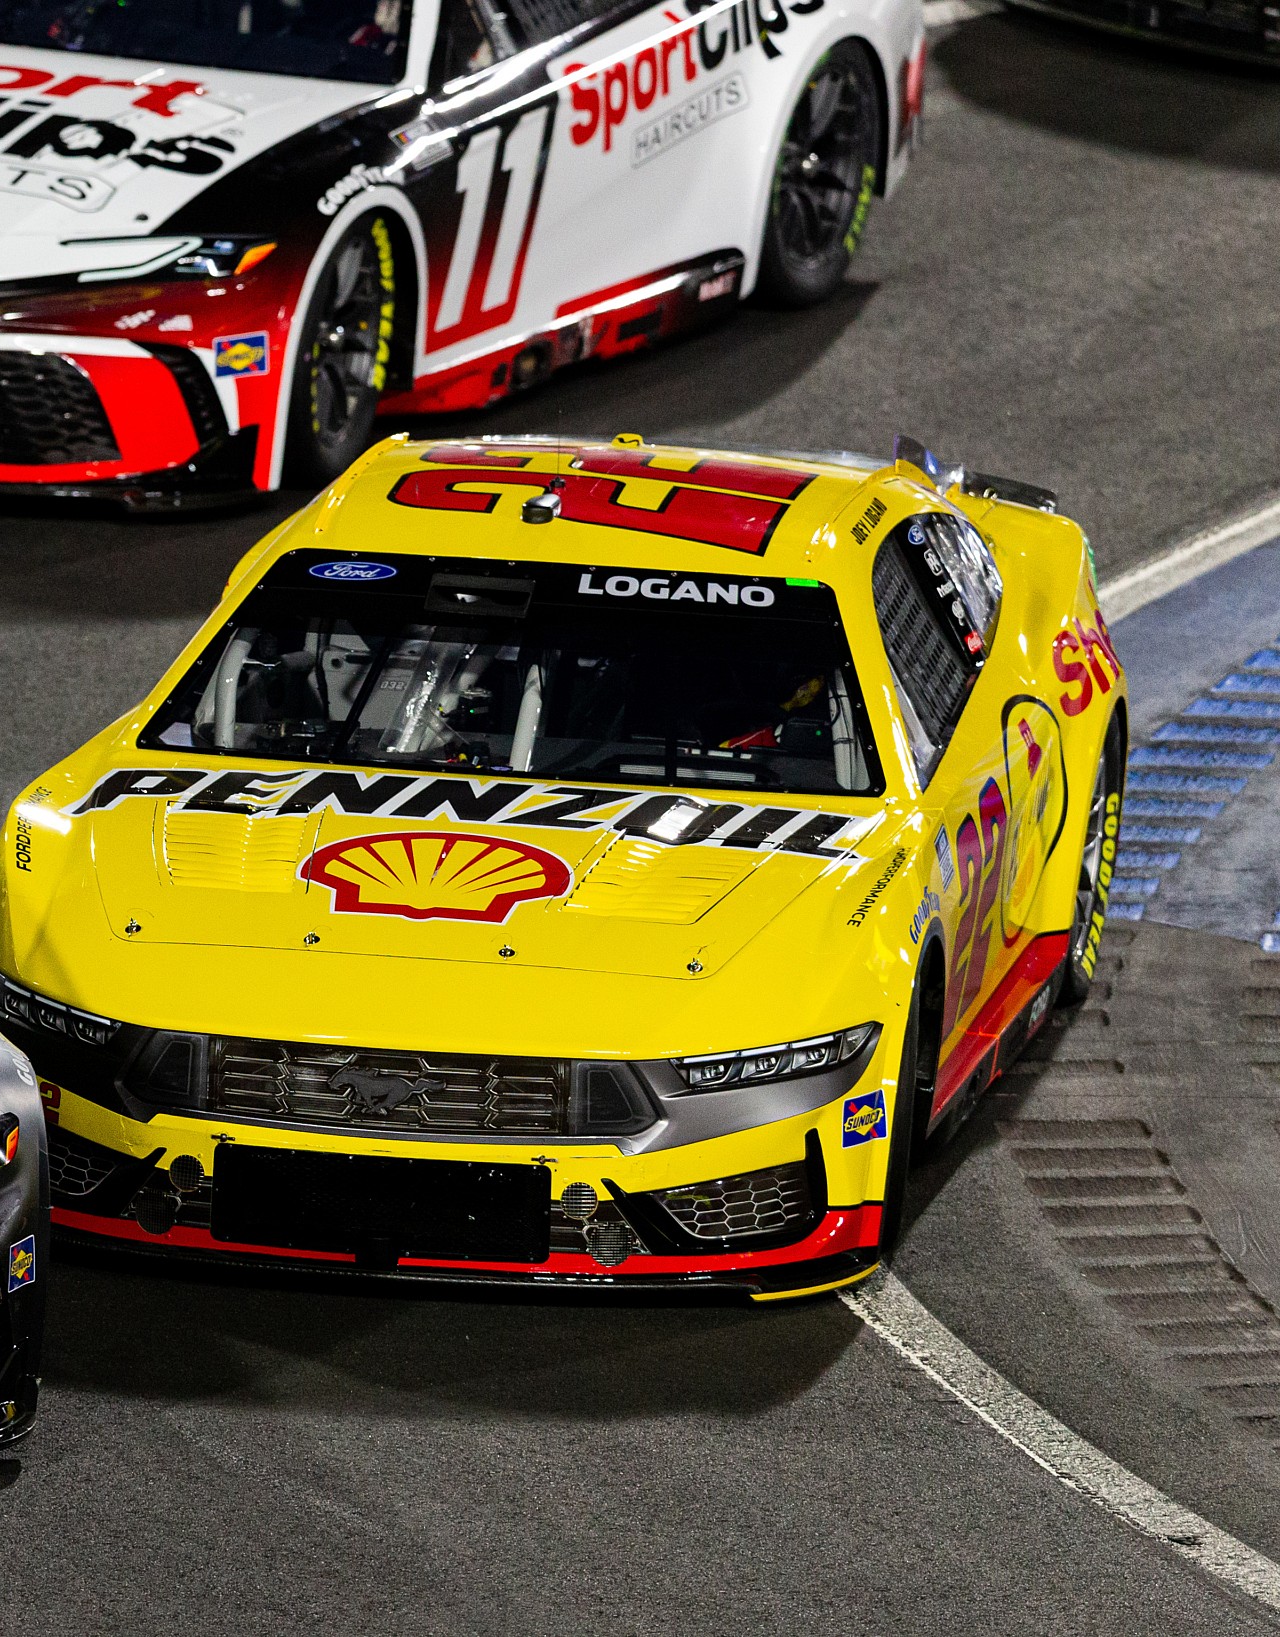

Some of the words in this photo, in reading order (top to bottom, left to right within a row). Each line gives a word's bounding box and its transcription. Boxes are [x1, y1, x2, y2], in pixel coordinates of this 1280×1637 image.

[634, 80, 742, 158] HAIRCUTS
[431, 105, 550, 334] 11
[387, 445, 821, 557] 22
[324, 563, 381, 578] Ford
[577, 572, 775, 607] LOGANO
[73, 768, 862, 866] PENNZOIL
[846, 1110, 881, 1130] SUNOCO
